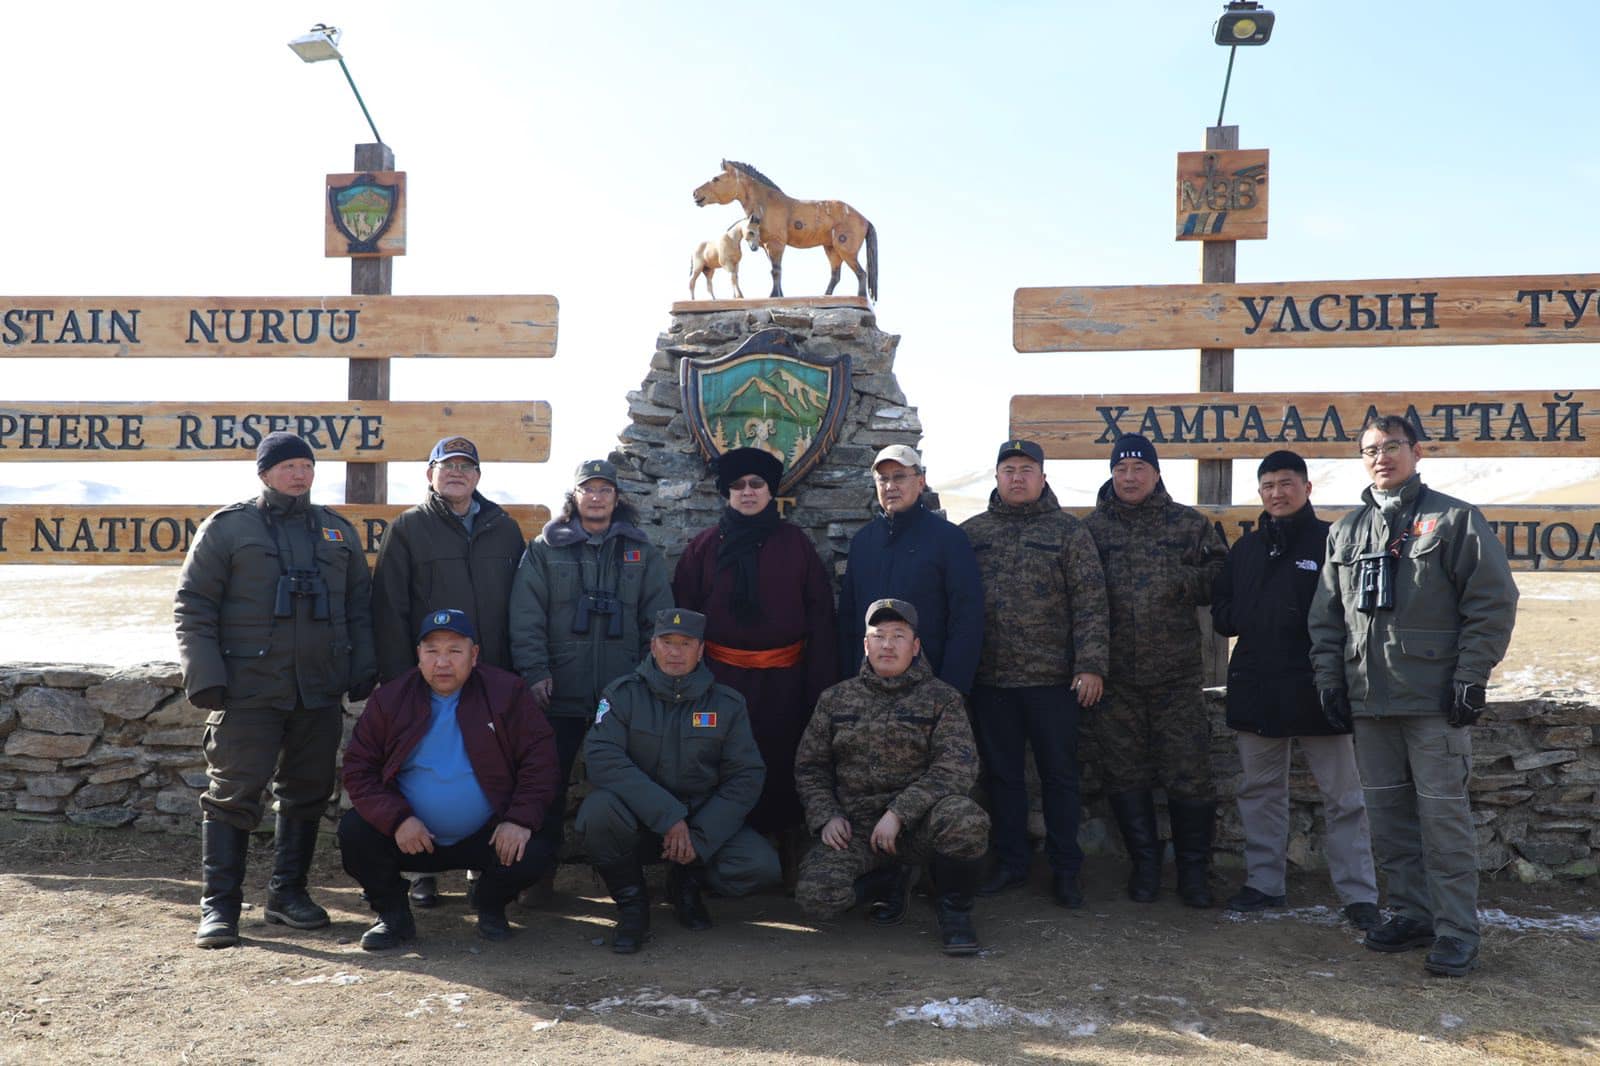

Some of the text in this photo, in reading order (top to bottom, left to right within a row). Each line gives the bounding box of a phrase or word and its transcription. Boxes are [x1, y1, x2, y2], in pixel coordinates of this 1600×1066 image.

[2, 309, 361, 345] STAIN NURUU
[1238, 289, 1600, 335] УЛСЫН ТУ
[0, 414, 145, 450] PHERE
[1487, 521, 1600, 569] ЦОЛ
